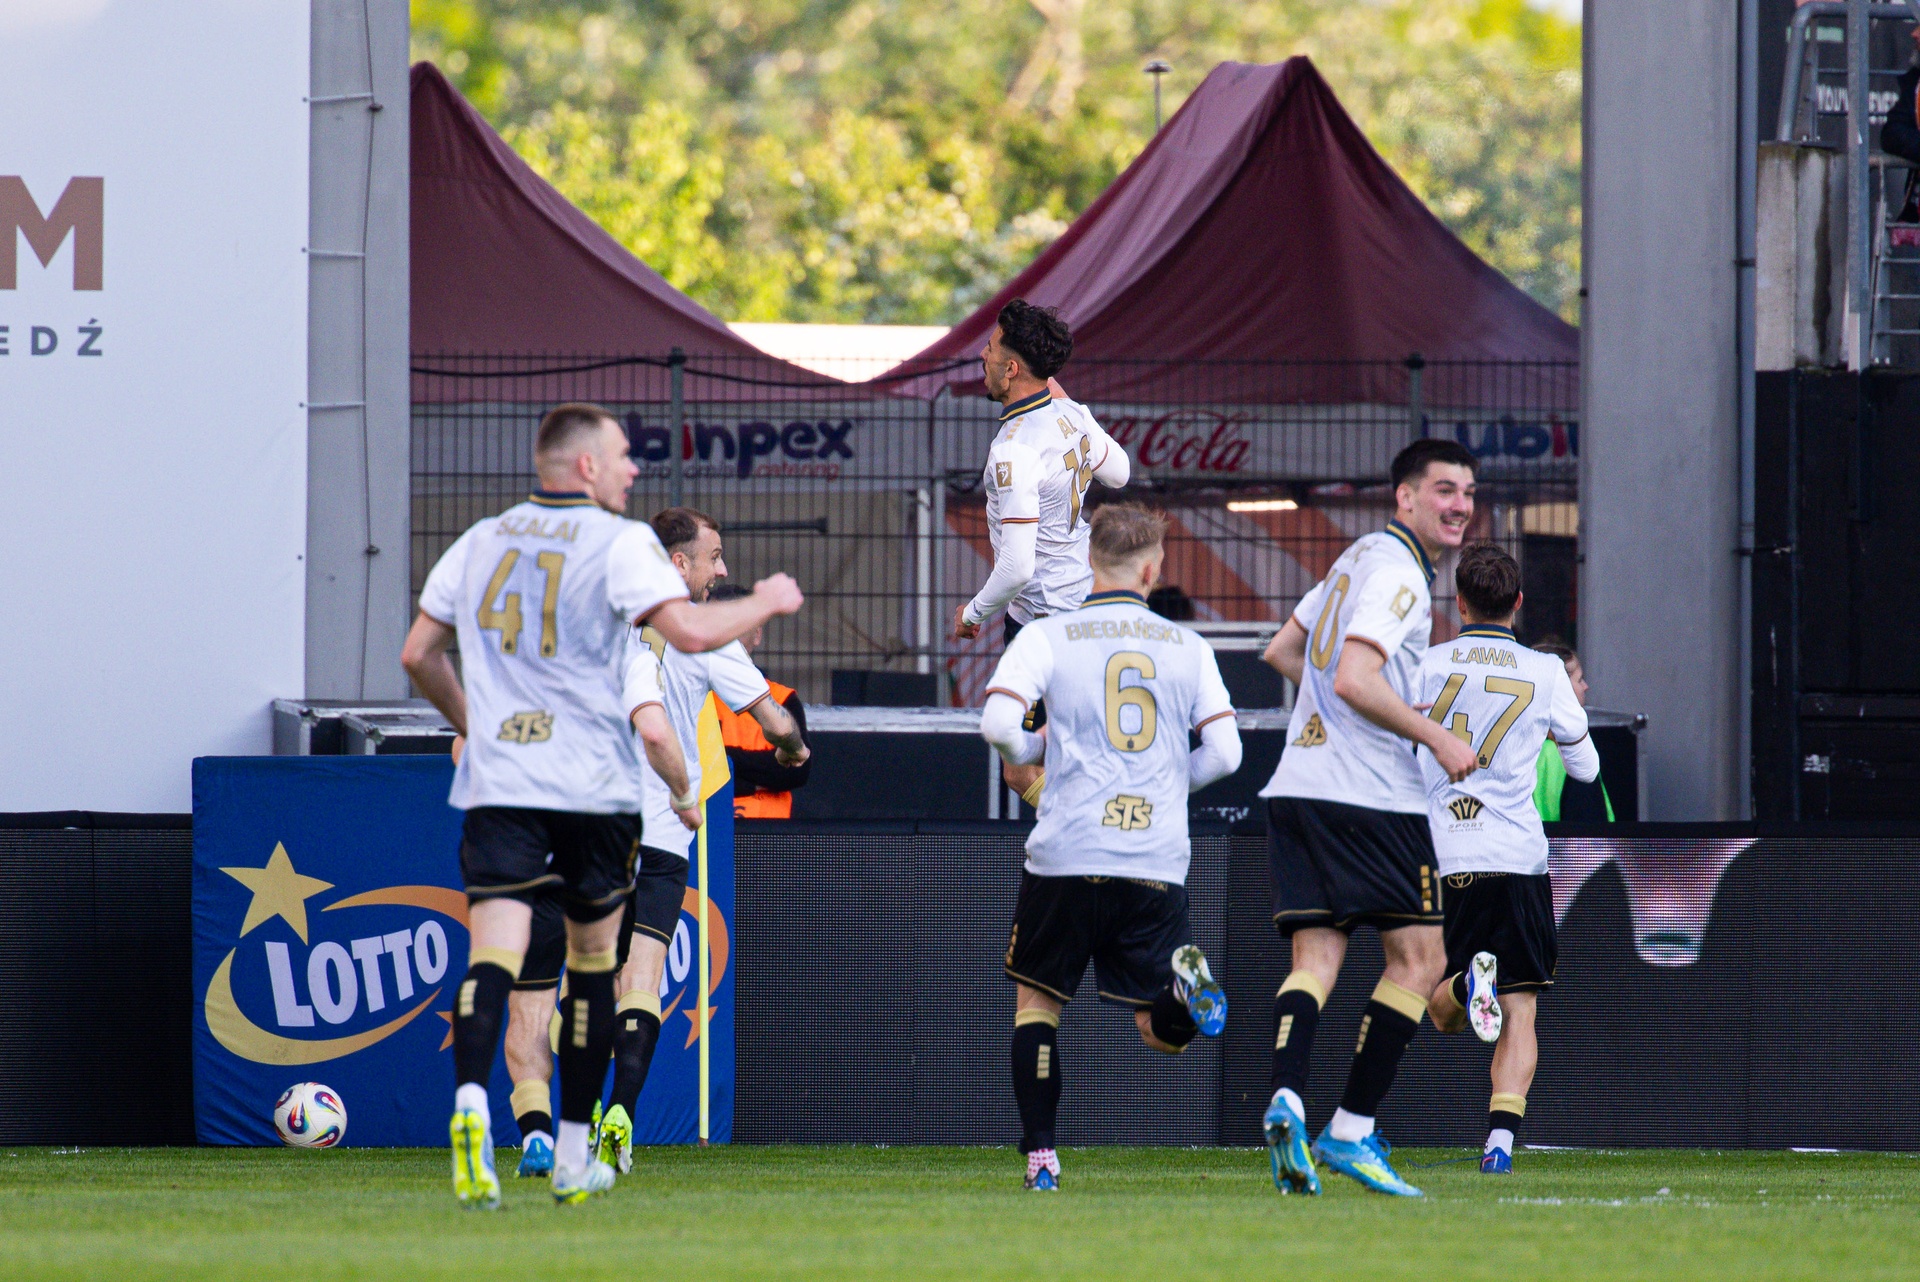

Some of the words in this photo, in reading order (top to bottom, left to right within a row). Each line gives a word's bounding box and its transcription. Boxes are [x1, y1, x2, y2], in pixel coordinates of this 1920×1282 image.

[625, 411, 853, 479] binpex
[496, 515, 580, 543] SZALAI
[478, 549, 566, 658] 41
[1065, 617, 1184, 645] BIEGAŃSKI
[1310, 568, 1350, 671] 0
[1450, 647, 1517, 668] ŁAWA
[497, 710, 553, 744] STS
[1104, 651, 1157, 752] 6
[1429, 673, 1535, 769] 47
[1101, 794, 1153, 831] STS
[265, 920, 449, 1027] LOTTO
